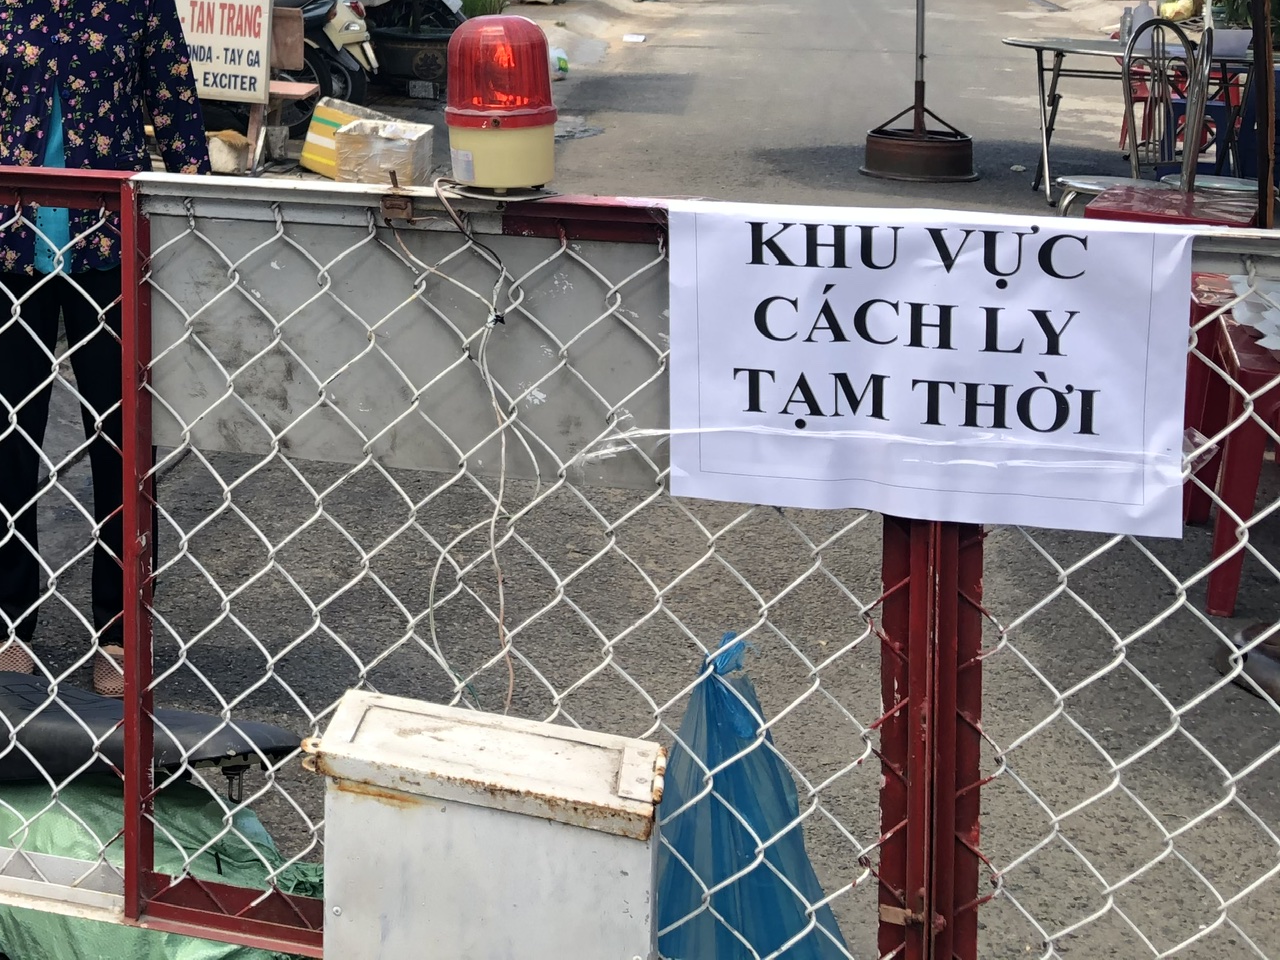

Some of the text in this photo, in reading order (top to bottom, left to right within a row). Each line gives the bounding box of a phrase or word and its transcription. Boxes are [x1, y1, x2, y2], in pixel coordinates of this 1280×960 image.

[219, 2, 262, 40] TRANG
[186, 44, 213, 64] ONDA
[223, 47, 244, 66] TAY
[247, 49, 261, 68] GA
[203, 71, 257, 92] EXCITER
[745, 221, 1089, 289] KHU VỰC
[753, 284, 1081, 357] CÁCH LY
[733, 368, 1102, 436] TẠM THỜI
